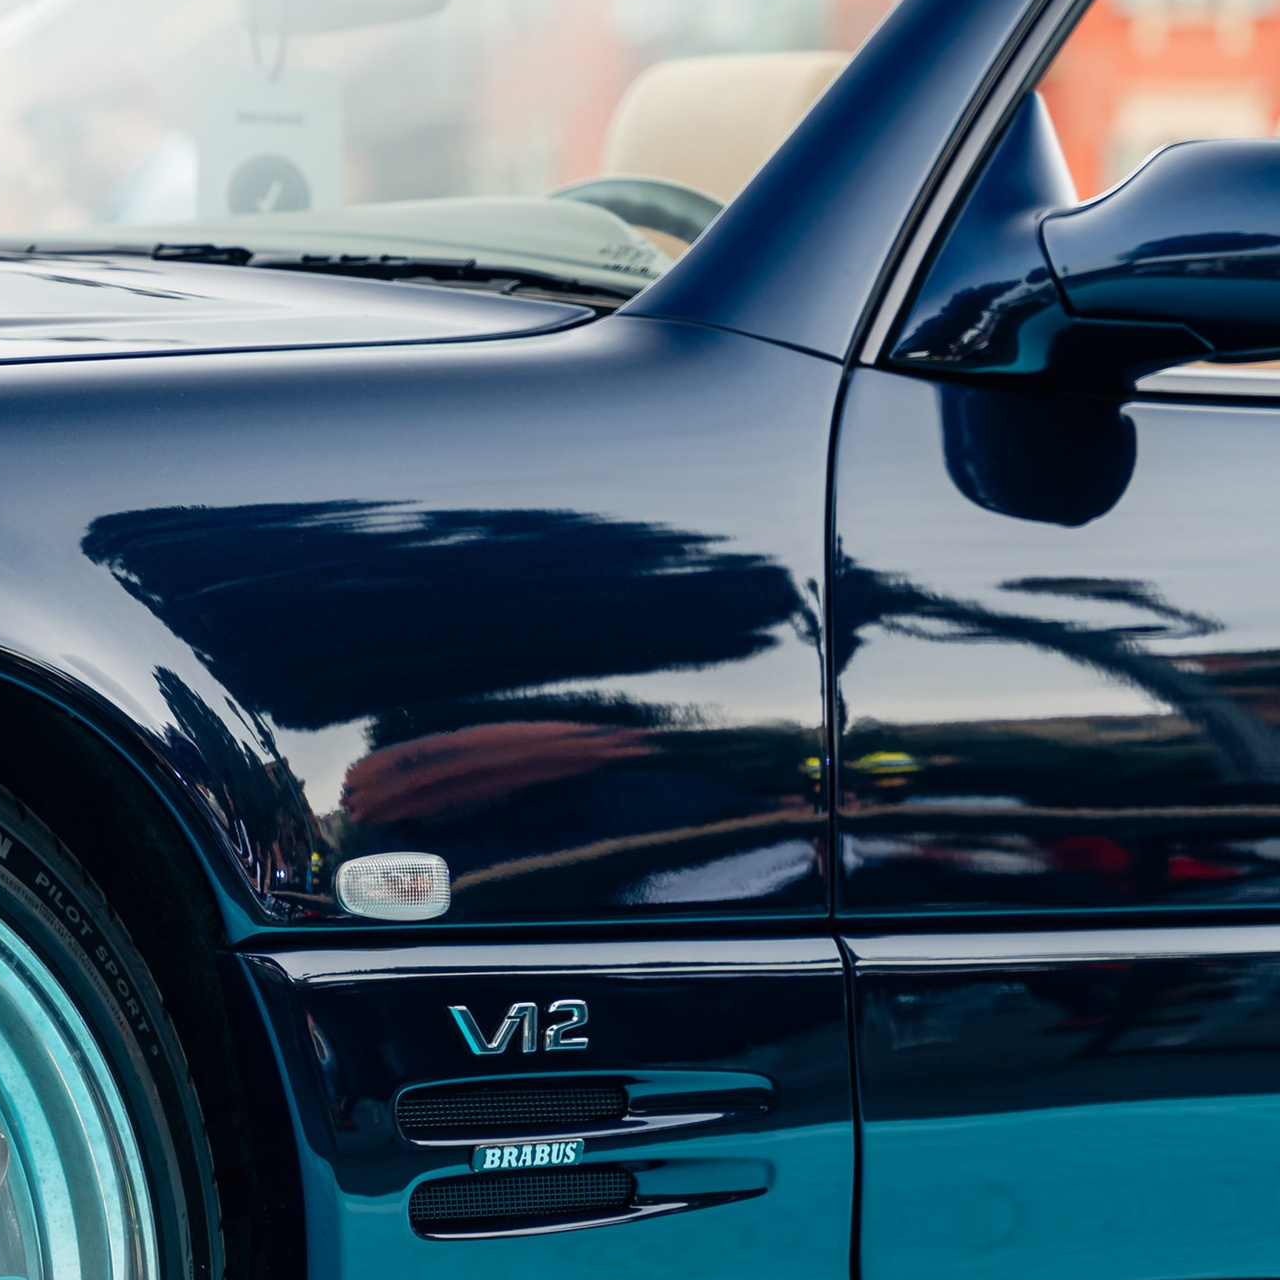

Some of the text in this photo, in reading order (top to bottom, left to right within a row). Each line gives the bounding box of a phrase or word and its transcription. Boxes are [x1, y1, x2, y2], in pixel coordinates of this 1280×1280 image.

[35, 871, 93, 937] PILOT
[95, 945, 150, 1033] SPORT
[449, 999, 589, 1055] V12
[483, 1141, 577, 1169] BRABUS
